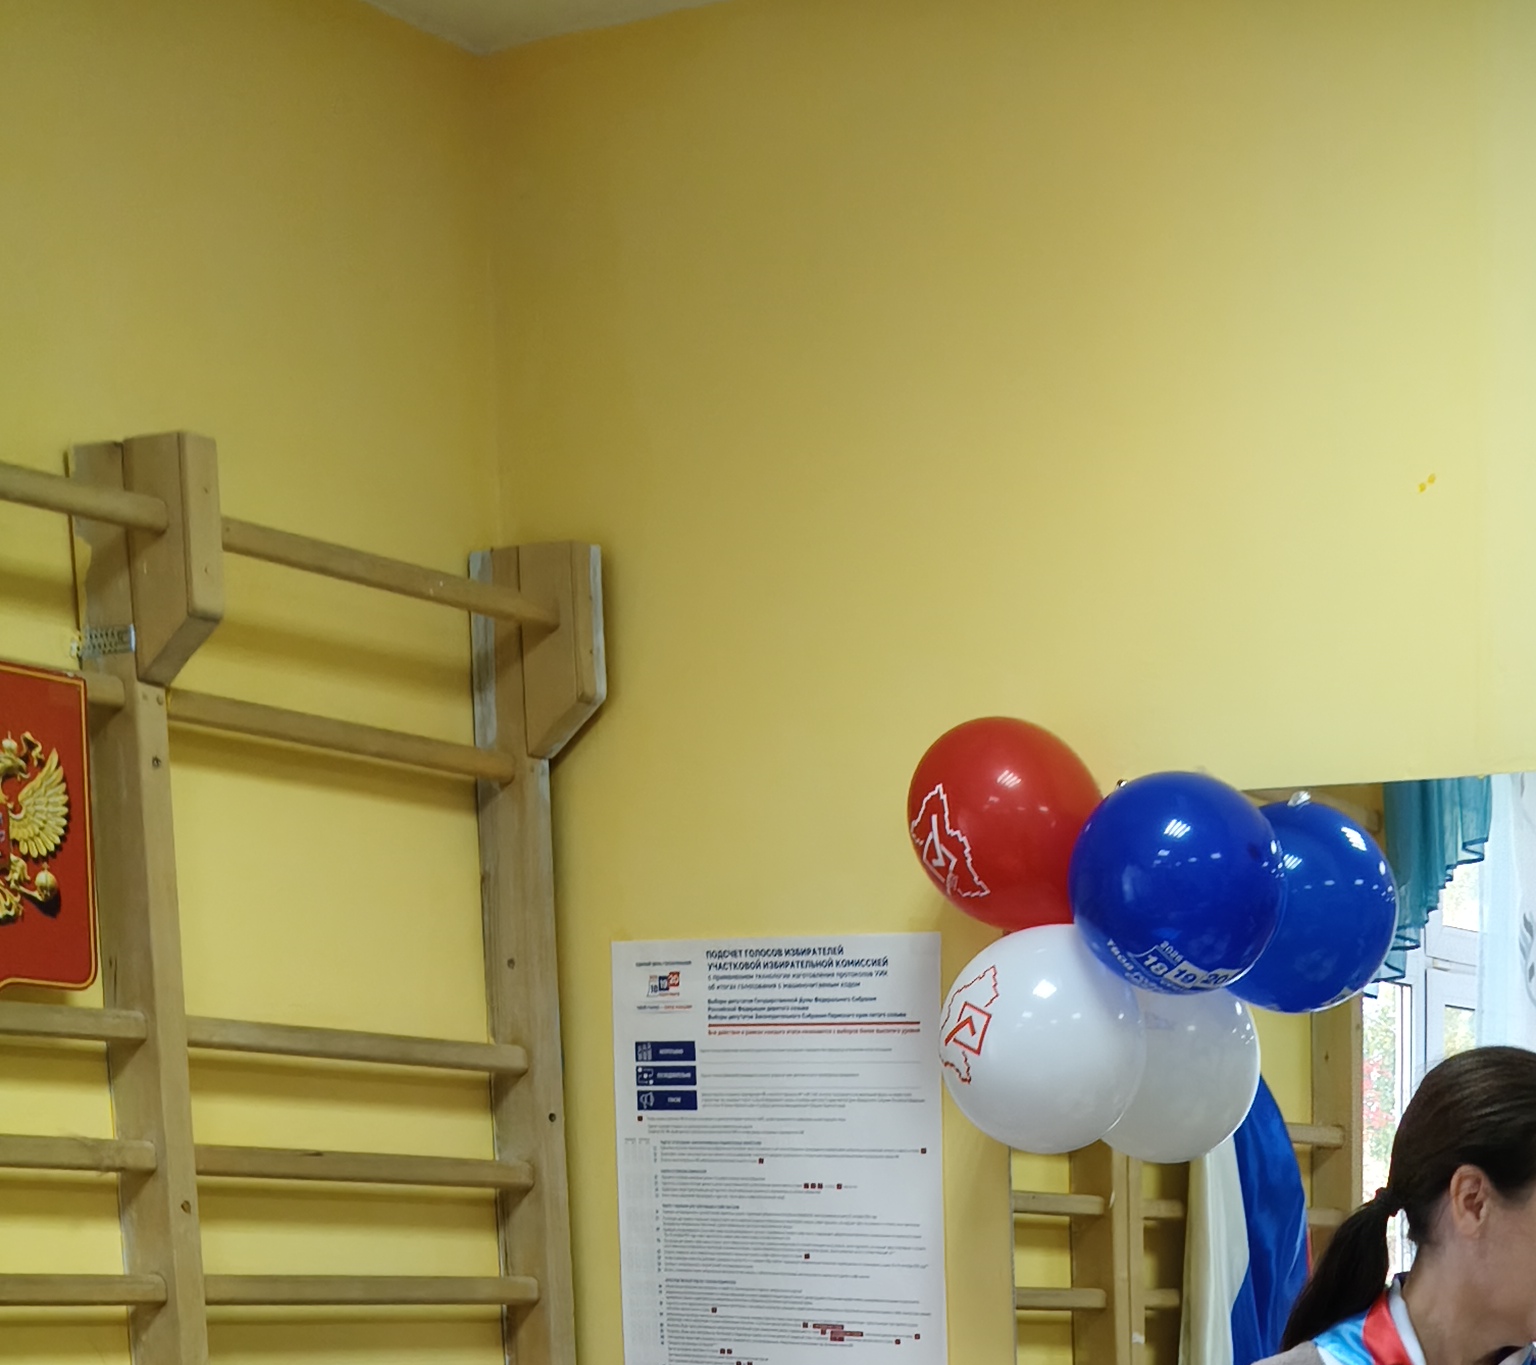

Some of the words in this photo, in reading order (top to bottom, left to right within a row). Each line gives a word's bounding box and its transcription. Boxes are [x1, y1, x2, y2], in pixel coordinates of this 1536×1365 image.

[744, 948, 783, 959] ГОЛОСОВ
[784, 945, 844, 957] ИЗБИРАТЕЛЕЙ
[707, 959, 761, 971] УЧАСТКОВОЙ
[763, 957, 834, 970] ИЗБИРАТЕЛЬНОЙ
[835, 956, 889, 969] КОМИССИЕЙ
[1143, 954, 1168, 976] 18
[1173, 967, 1197, 984] 19
